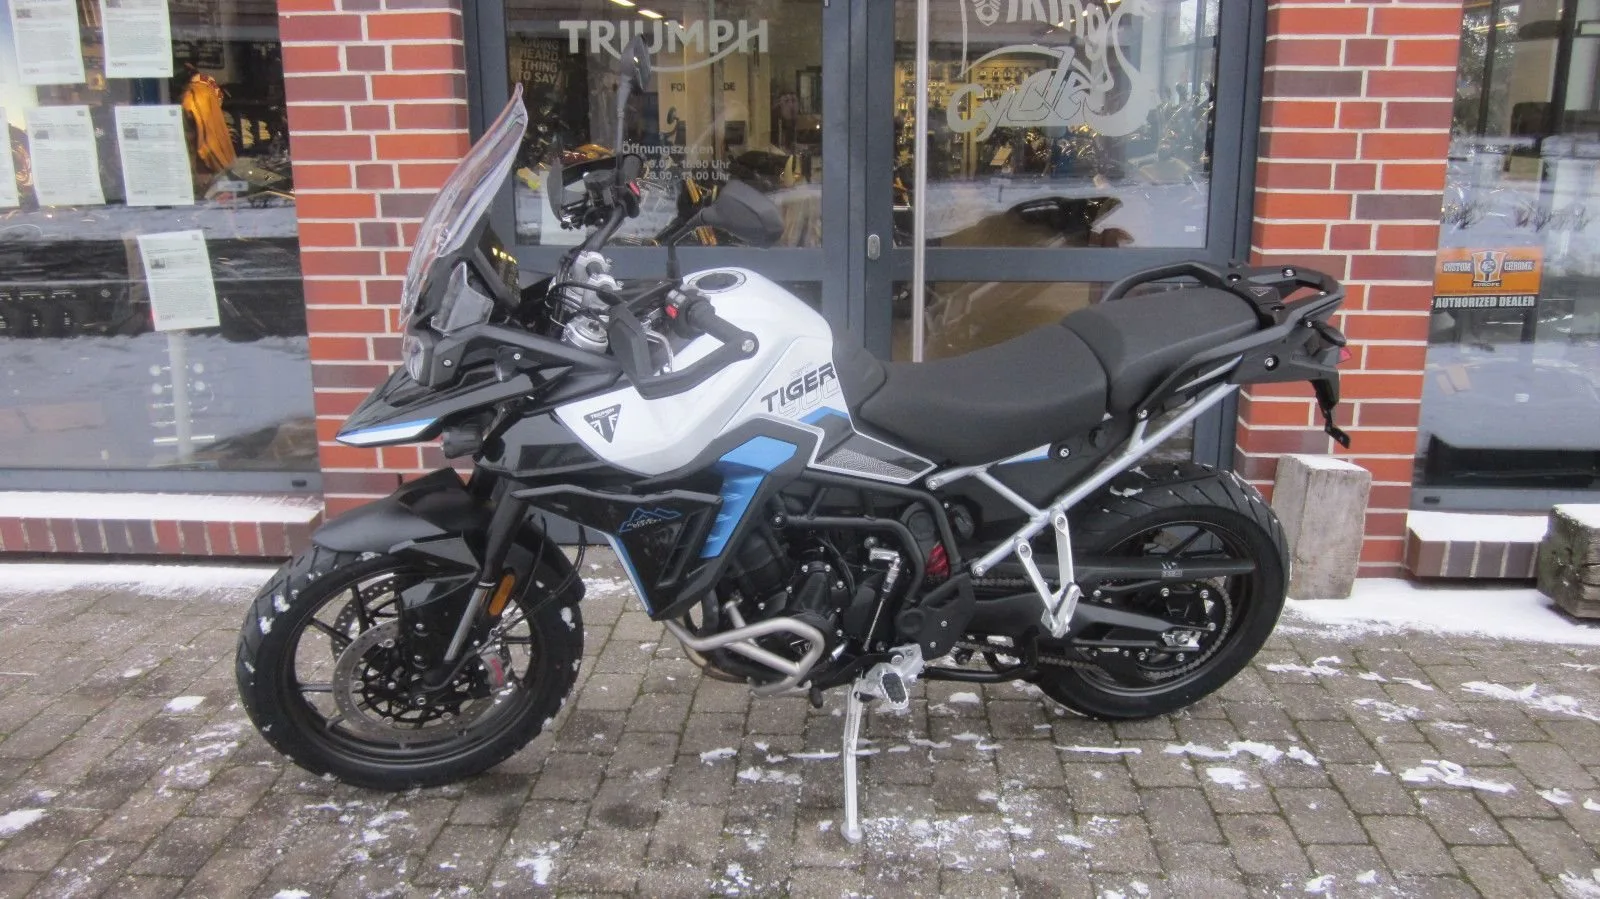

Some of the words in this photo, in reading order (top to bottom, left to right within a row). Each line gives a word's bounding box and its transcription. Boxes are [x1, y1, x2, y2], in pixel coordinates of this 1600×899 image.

[559, 20, 769, 71] TRIUMPH
[534, 72, 557, 84] SAY
[712, 160, 731, 169] Uhr
[712, 171, 731, 180] Uhr
[1435, 296, 1497, 308] AUTHORIZED
[1499, 296, 1535, 307] DEALER
[761, 362, 836, 412] TIGER
